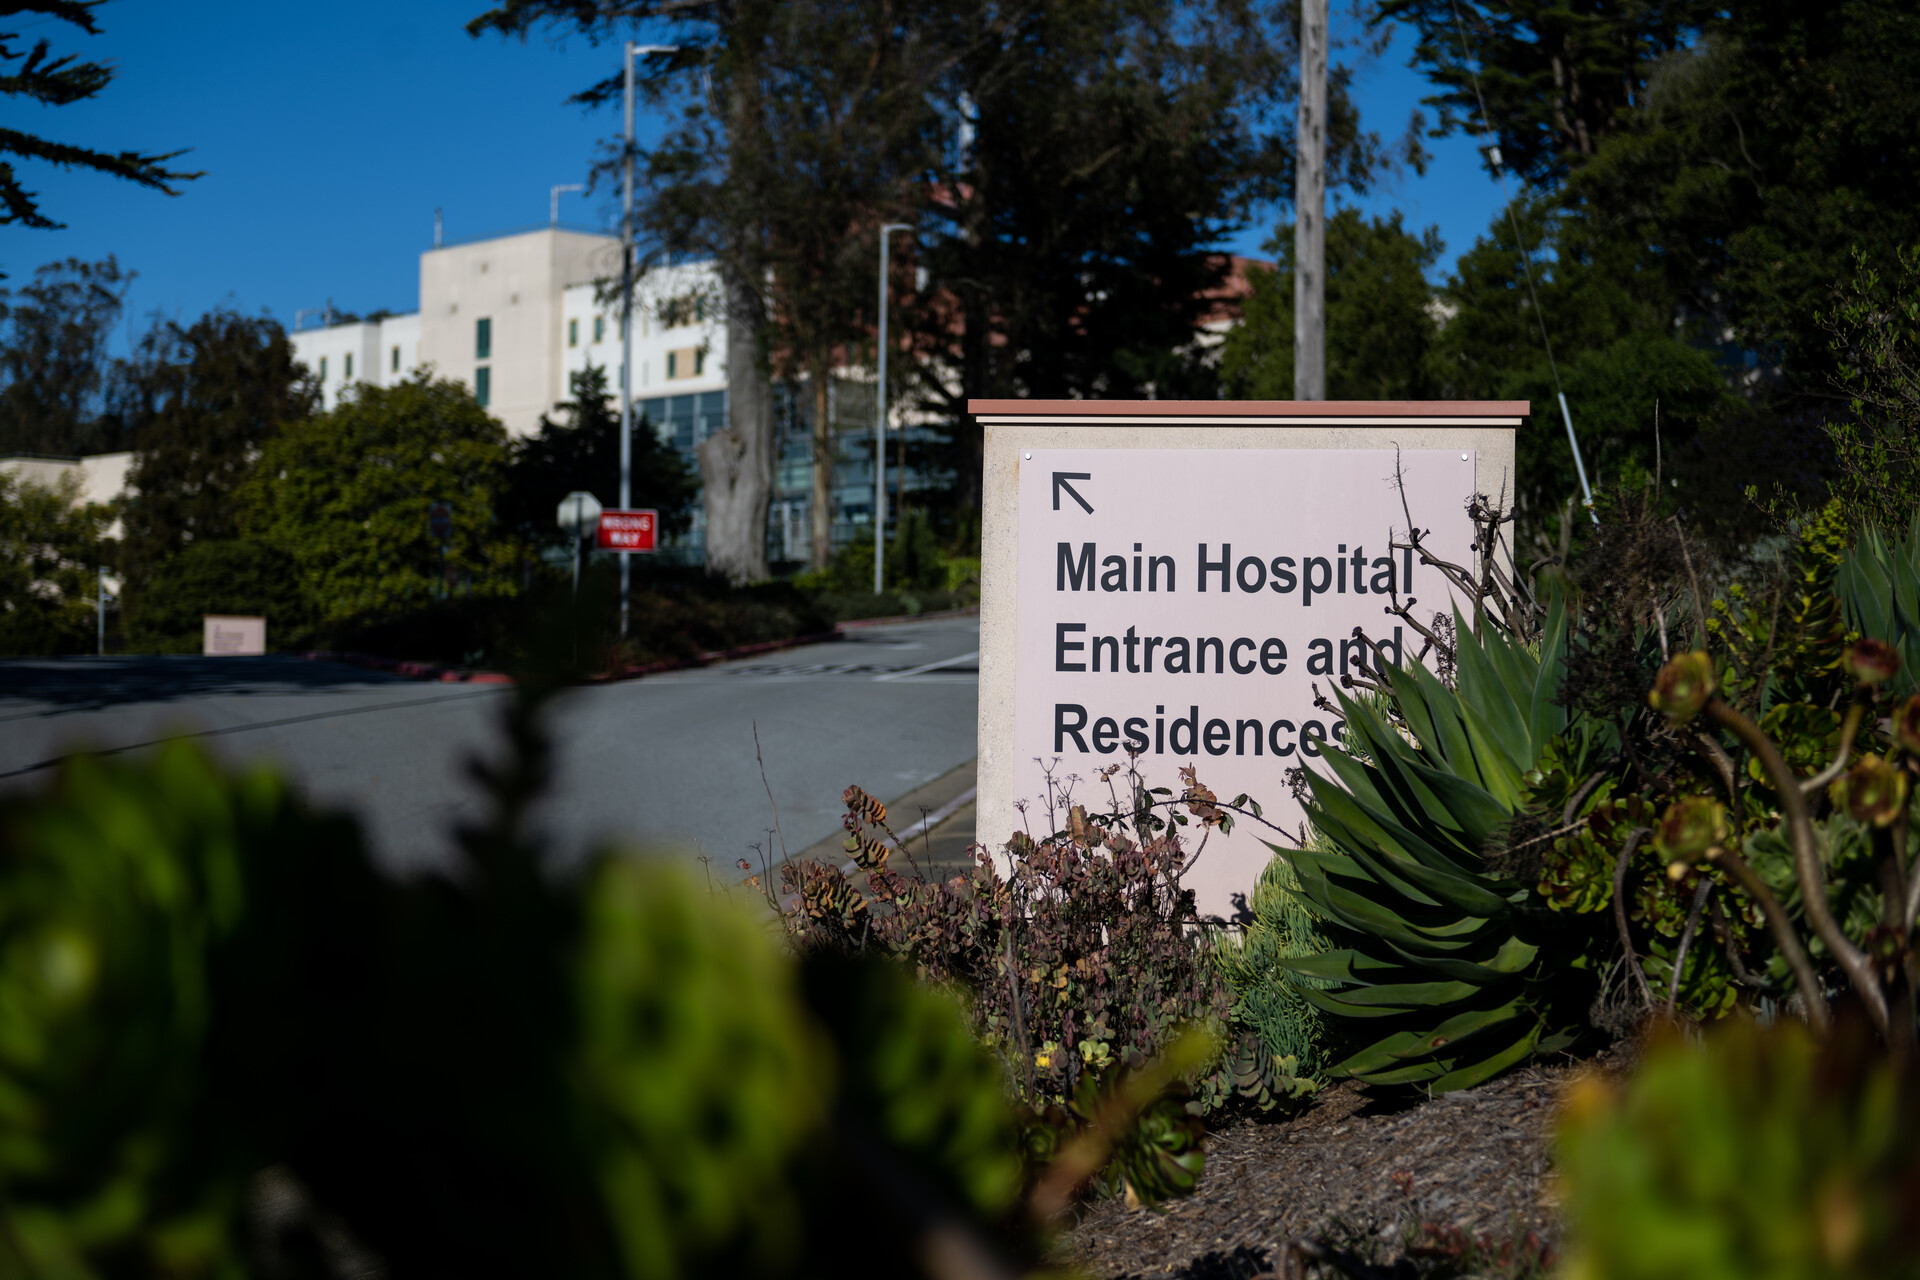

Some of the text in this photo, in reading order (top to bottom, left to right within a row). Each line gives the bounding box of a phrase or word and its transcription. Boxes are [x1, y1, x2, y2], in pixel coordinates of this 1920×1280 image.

[601, 516, 650, 531] WRONG
[609, 531, 640, 546] WAY
[1056, 542, 1413, 607] Main Hospital
[1055, 623, 1403, 676] Entrance and
